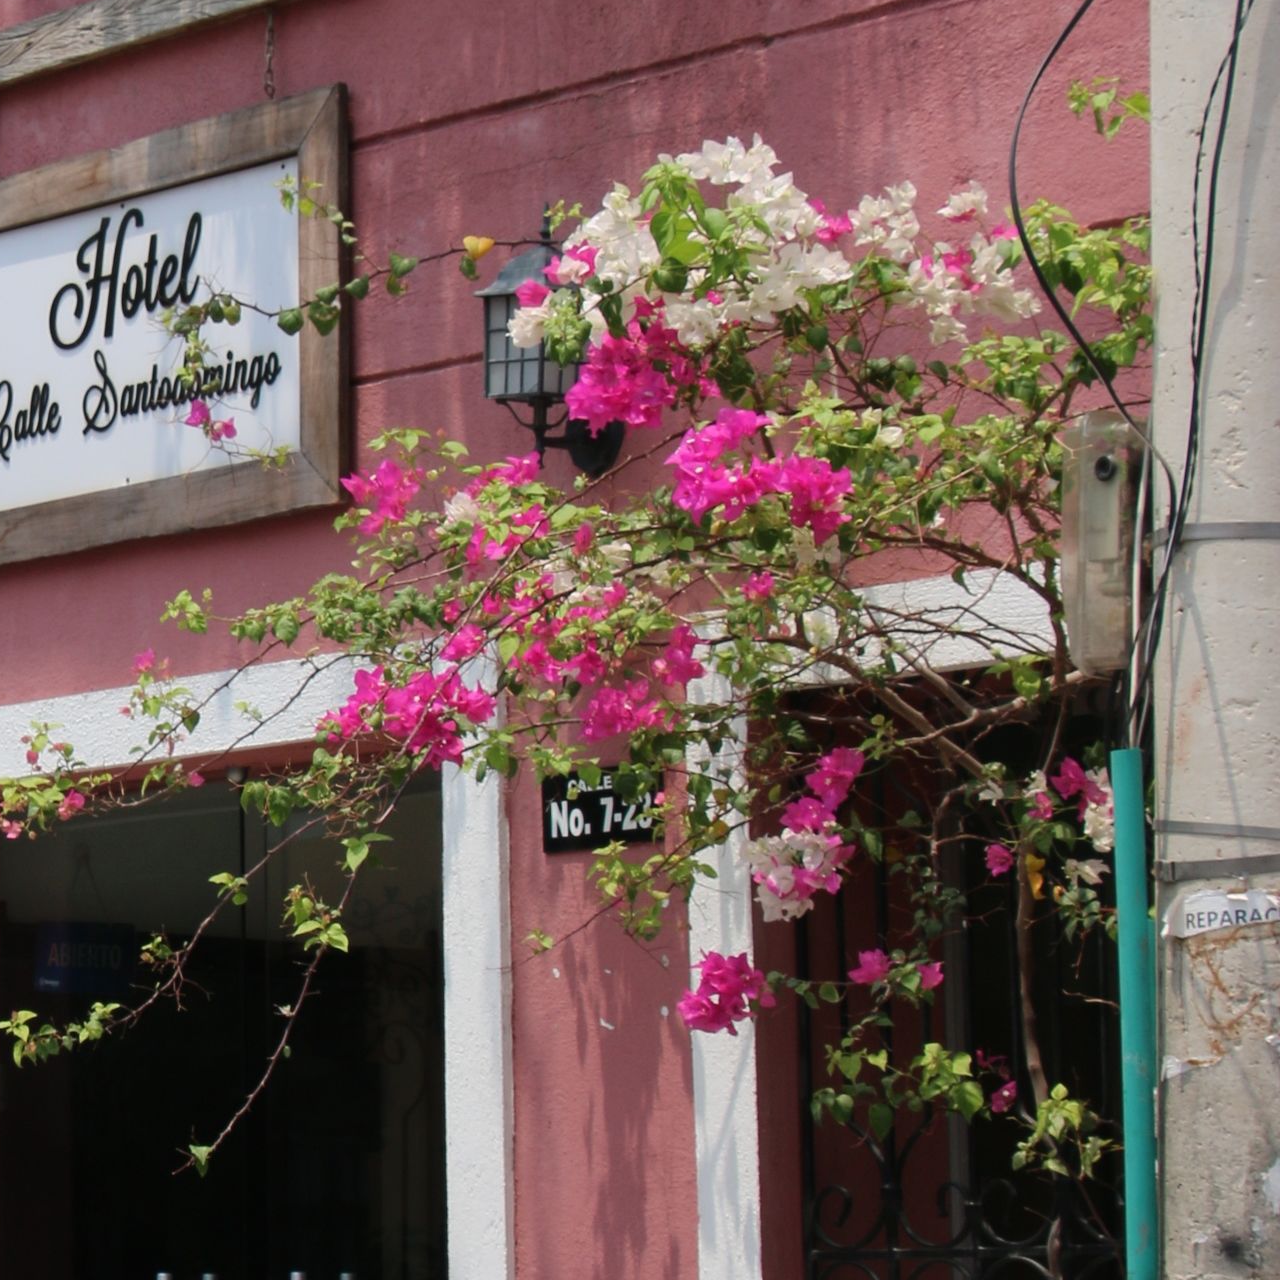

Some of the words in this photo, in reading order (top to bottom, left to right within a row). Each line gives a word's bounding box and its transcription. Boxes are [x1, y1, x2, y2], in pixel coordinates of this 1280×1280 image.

[48, 208, 203, 350] Hotel
[82, 349, 283, 435] Santodomingo
[550, 800, 592, 839] No.
